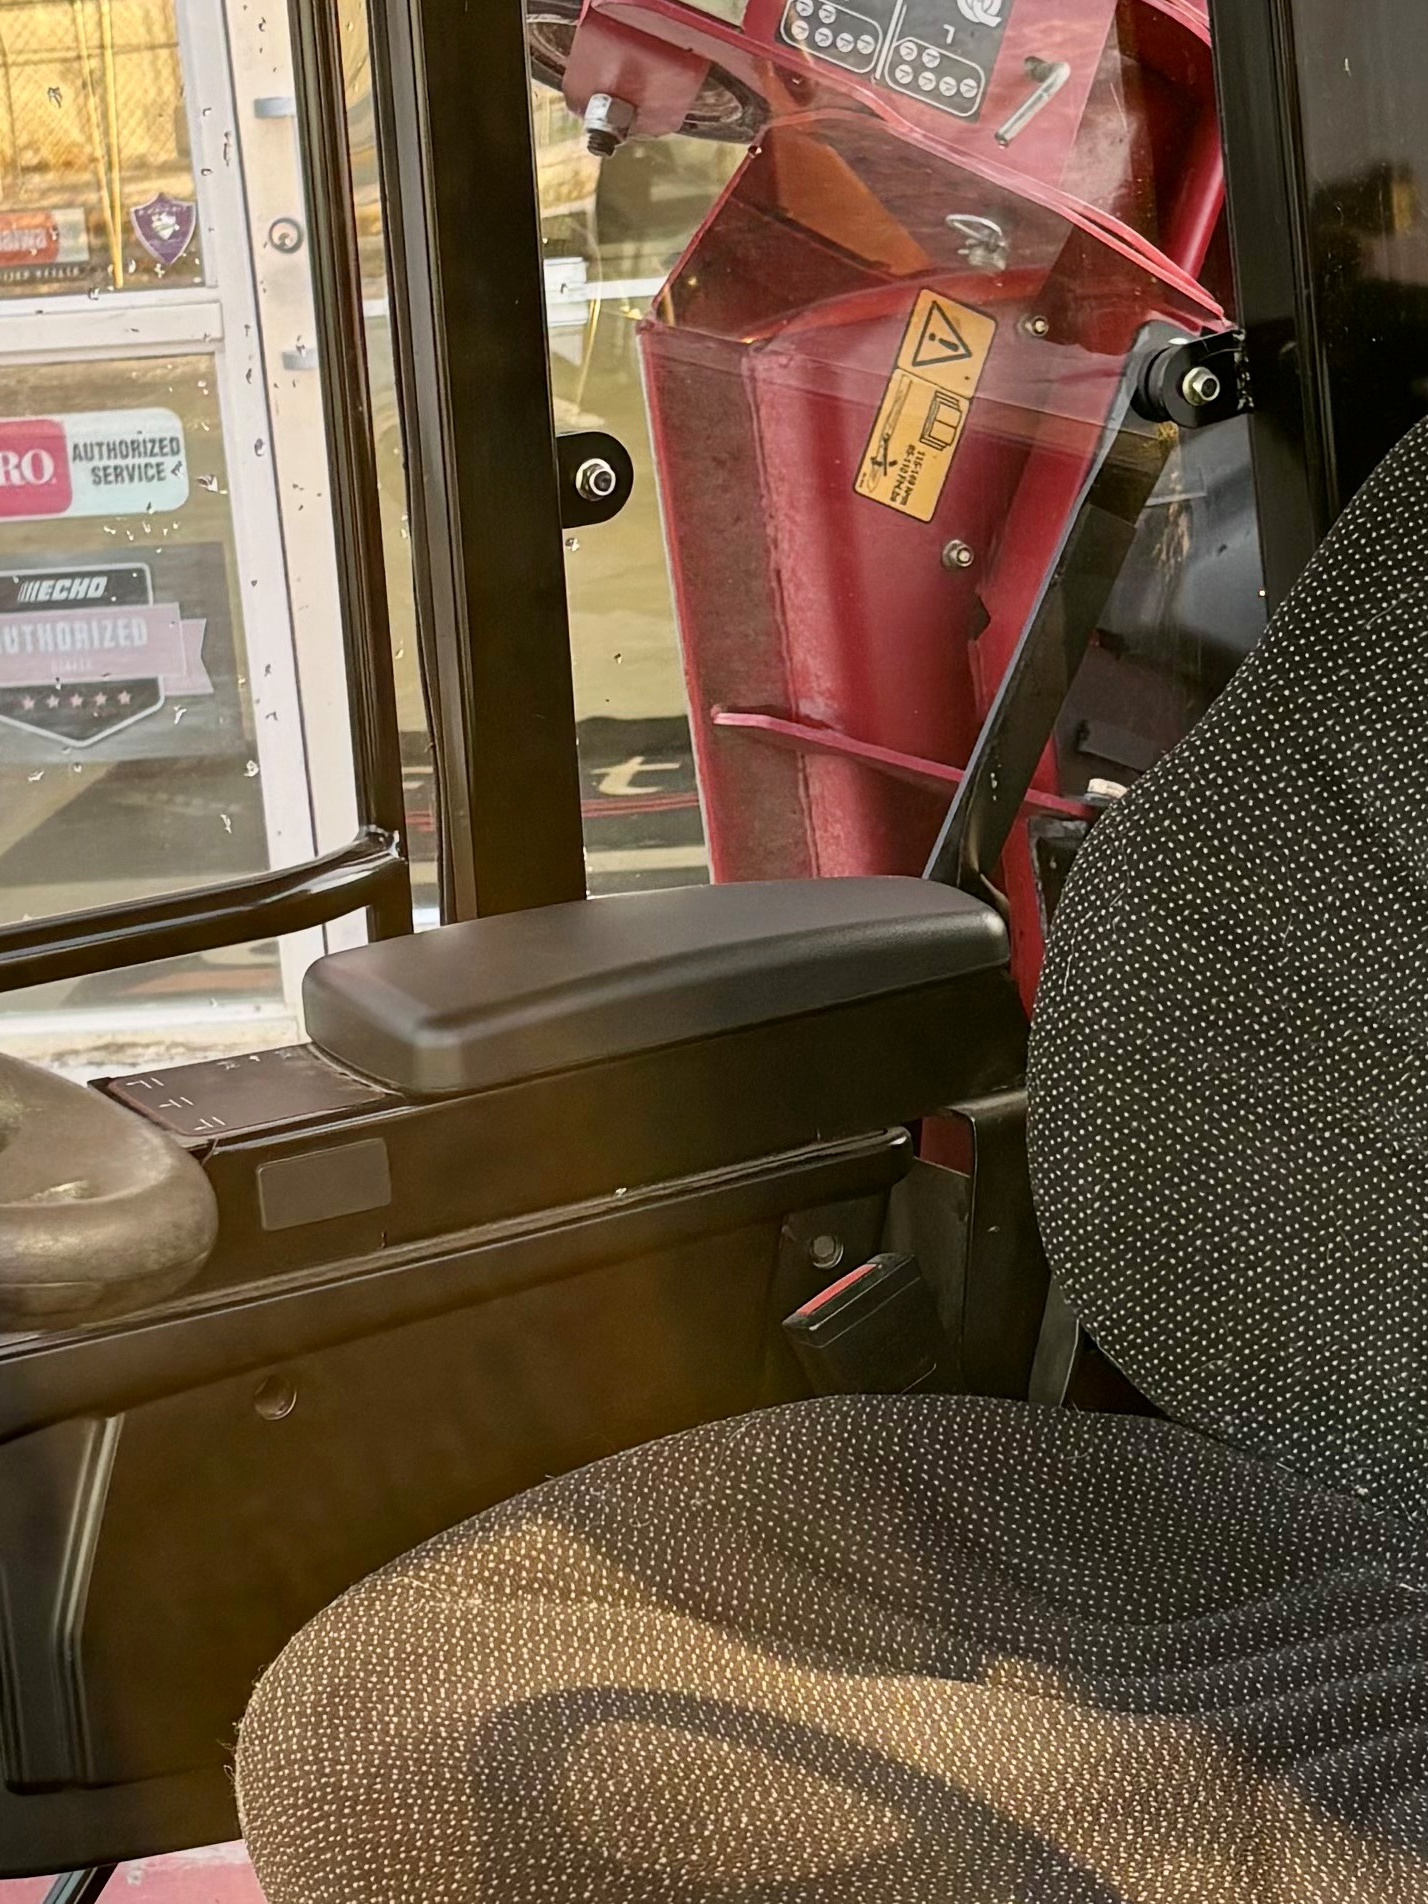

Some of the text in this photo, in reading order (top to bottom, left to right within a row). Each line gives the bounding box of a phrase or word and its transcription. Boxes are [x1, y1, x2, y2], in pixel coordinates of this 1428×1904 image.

[72, 436, 181, 463] AUTHORIZED
[91, 461, 167, 487] SERVICE
[34, 576, 108, 602] ECHO
